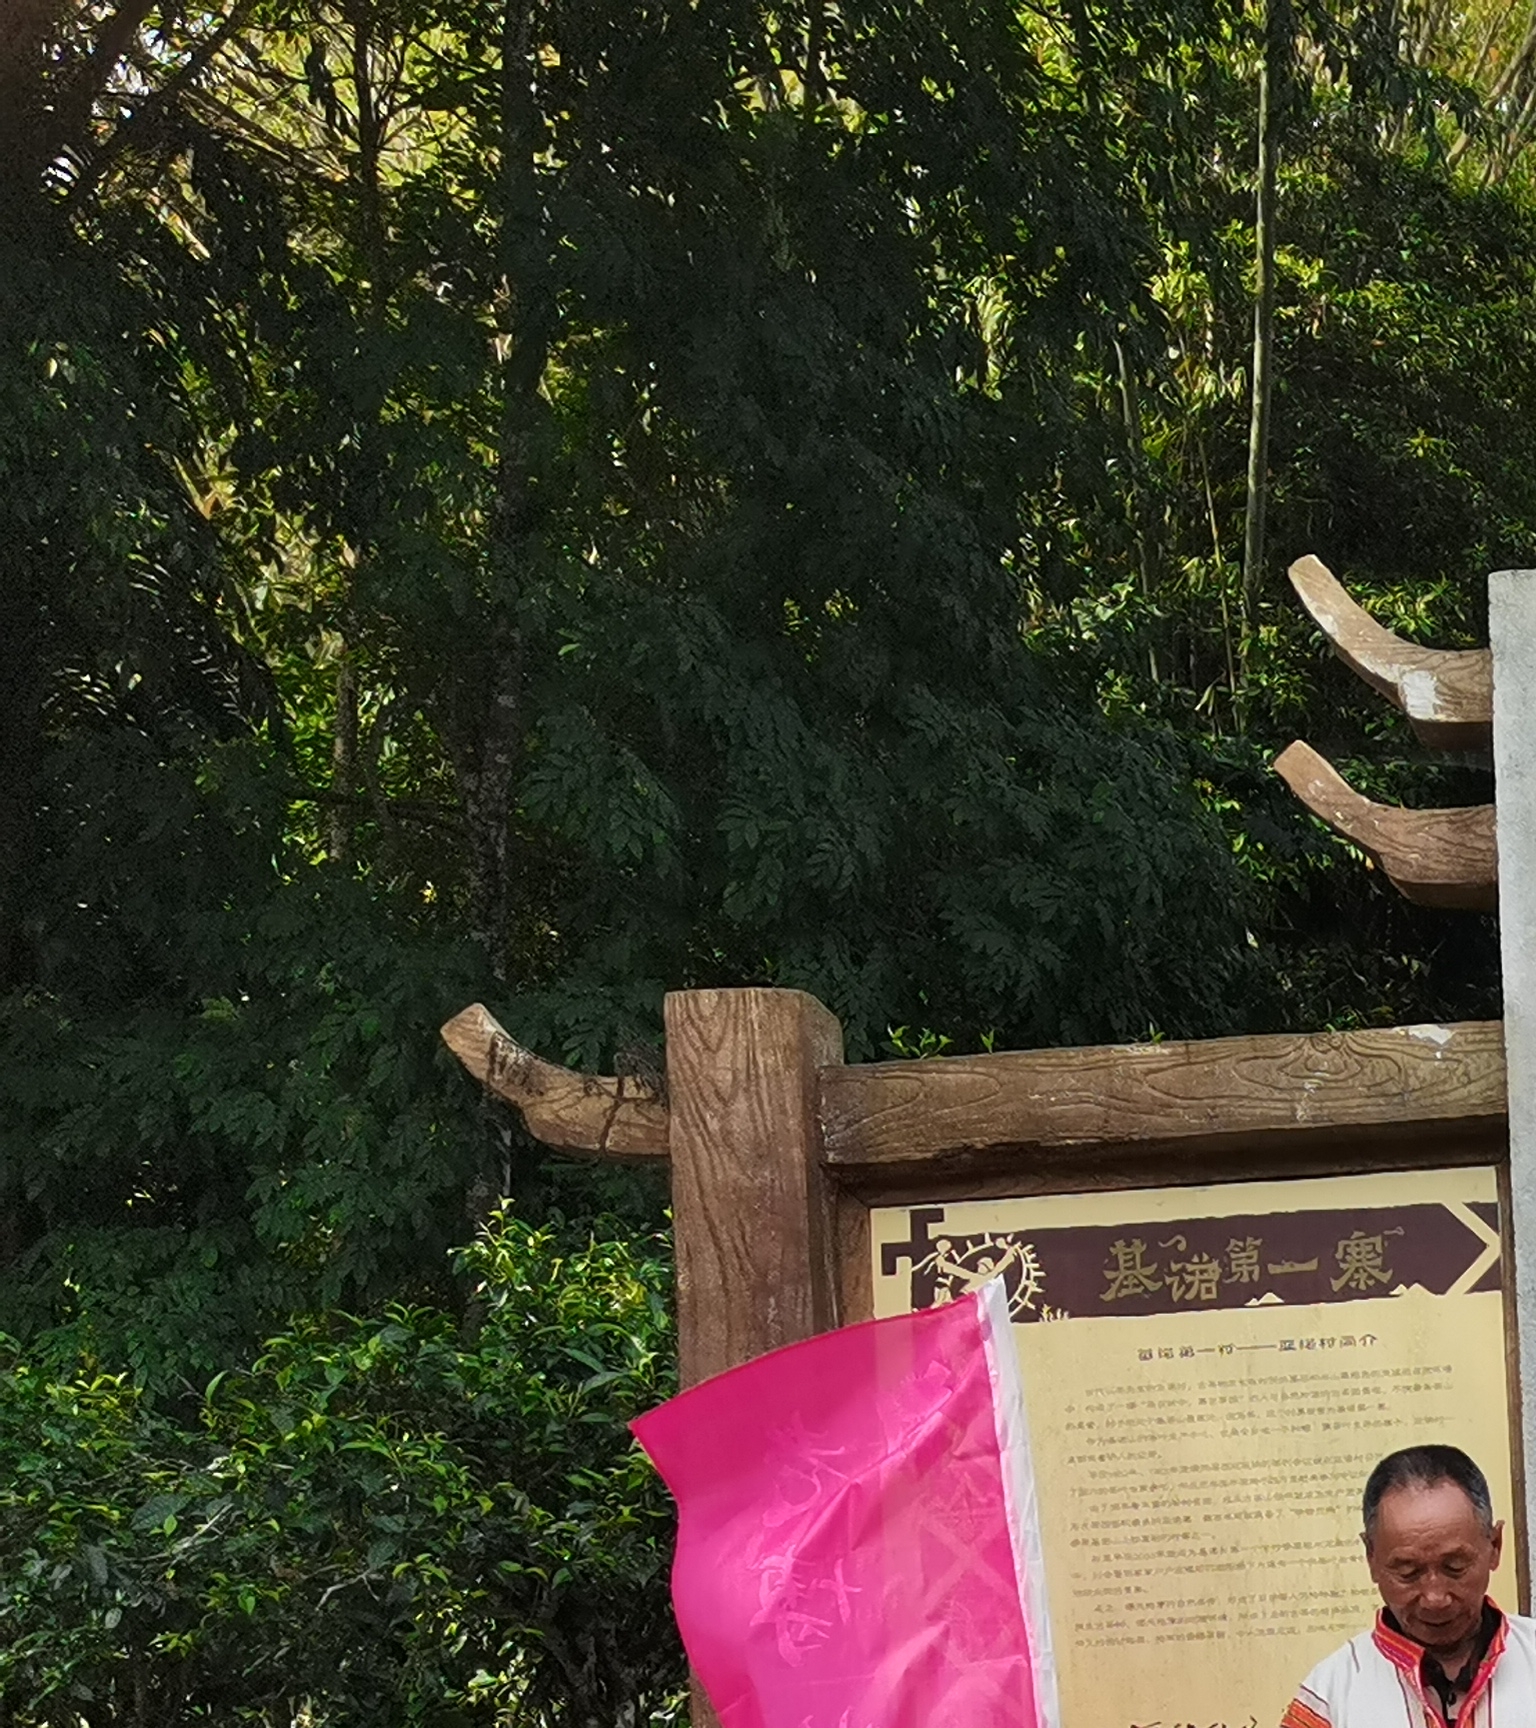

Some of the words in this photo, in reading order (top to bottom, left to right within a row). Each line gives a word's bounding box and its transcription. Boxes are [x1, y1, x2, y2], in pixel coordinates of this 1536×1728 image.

[1099, 1230, 1394, 1303] 基诺第一寨
